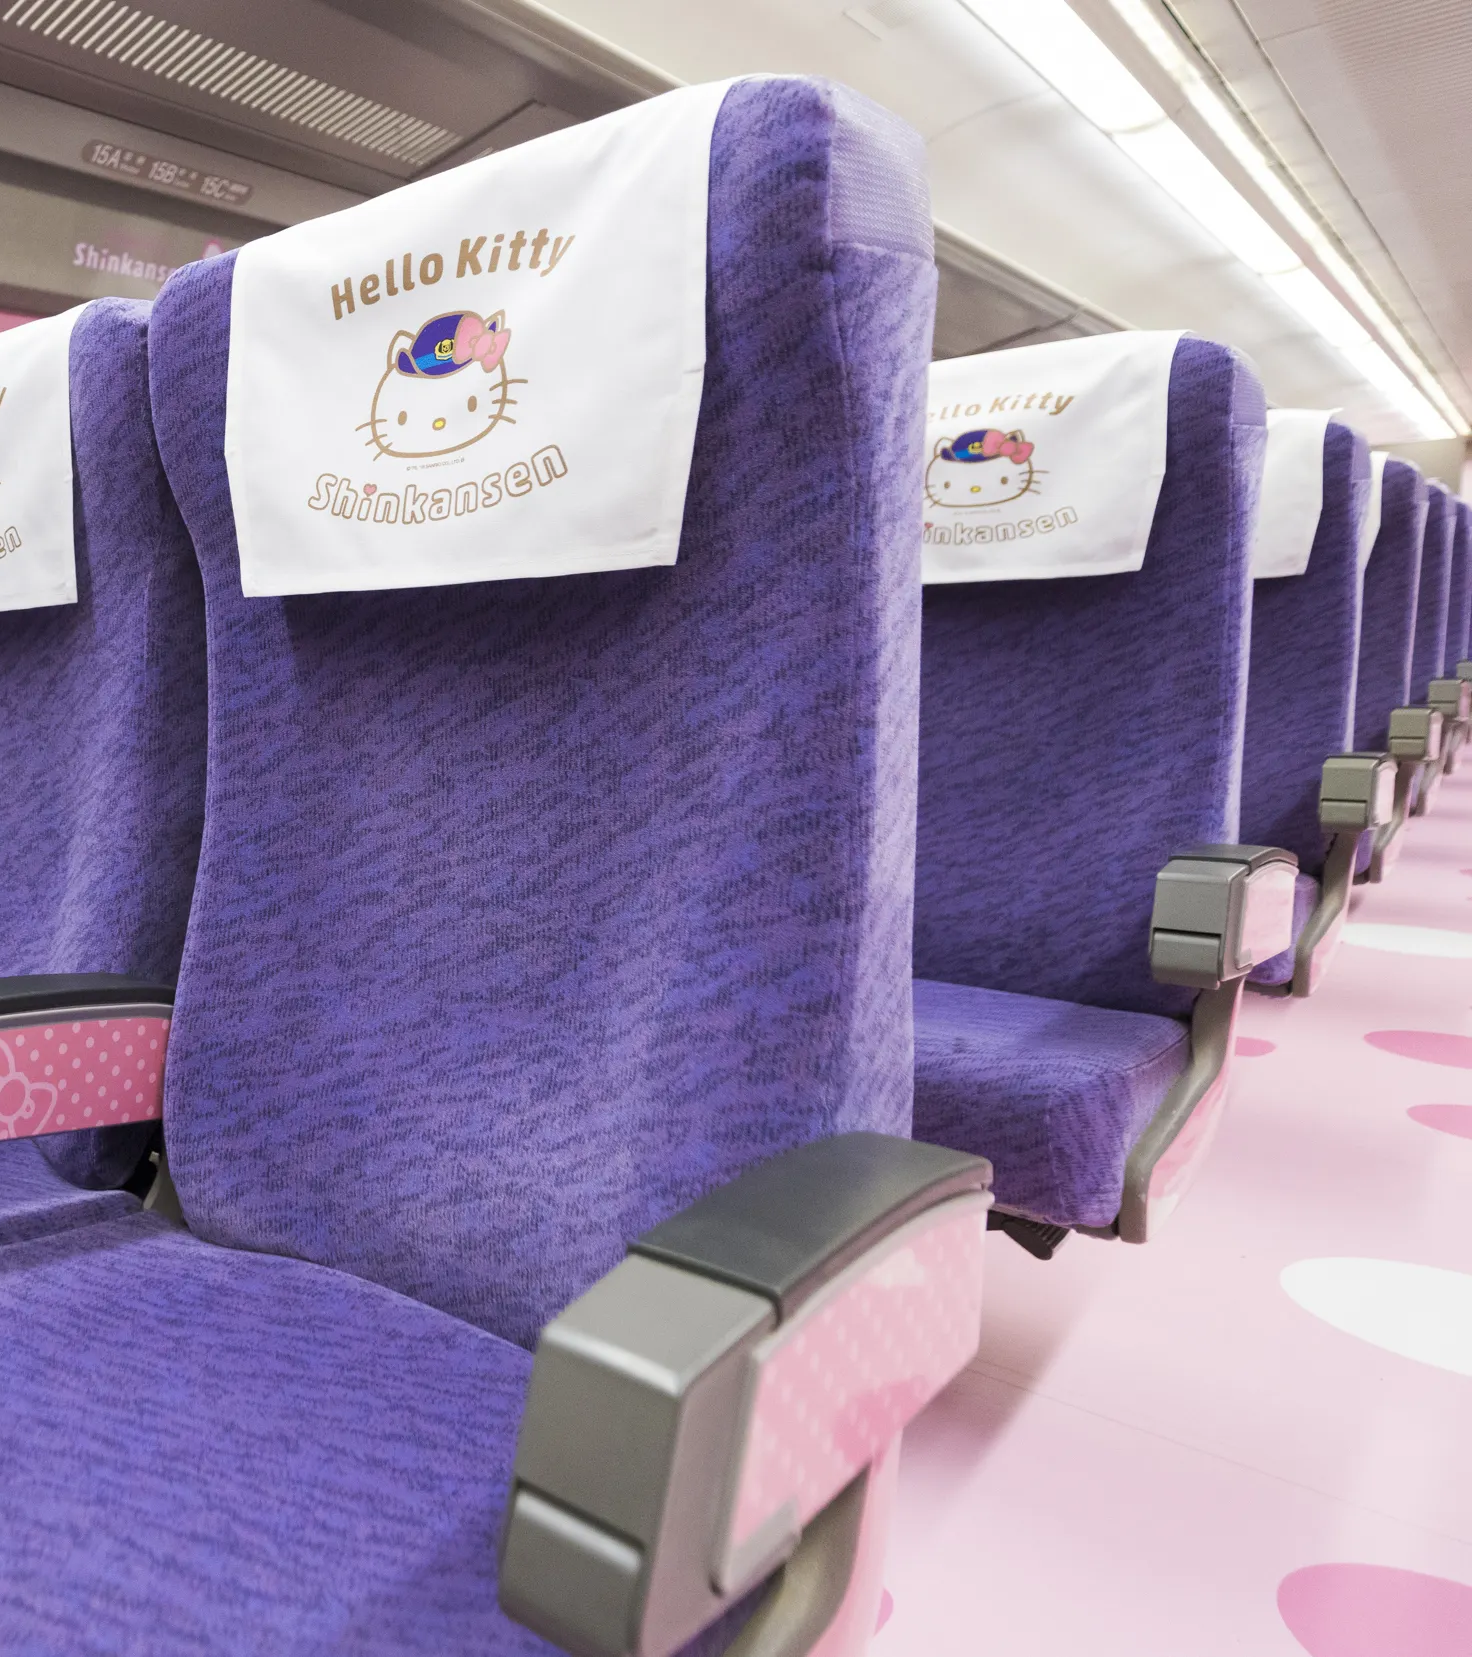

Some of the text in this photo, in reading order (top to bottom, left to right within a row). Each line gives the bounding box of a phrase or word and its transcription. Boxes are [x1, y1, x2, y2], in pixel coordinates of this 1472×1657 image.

[91, 143, 122, 169] 15A
[148, 160, 178, 184] 15B
[200, 175, 229, 198] 15C
[73, 243, 177, 283] Shinkans
[330, 228, 576, 321] Hello Kitty
[927, 391, 1075, 423] ello Kitty
[308, 444, 568, 525] Shinkansen
[923, 506, 1078, 546] inkansen
